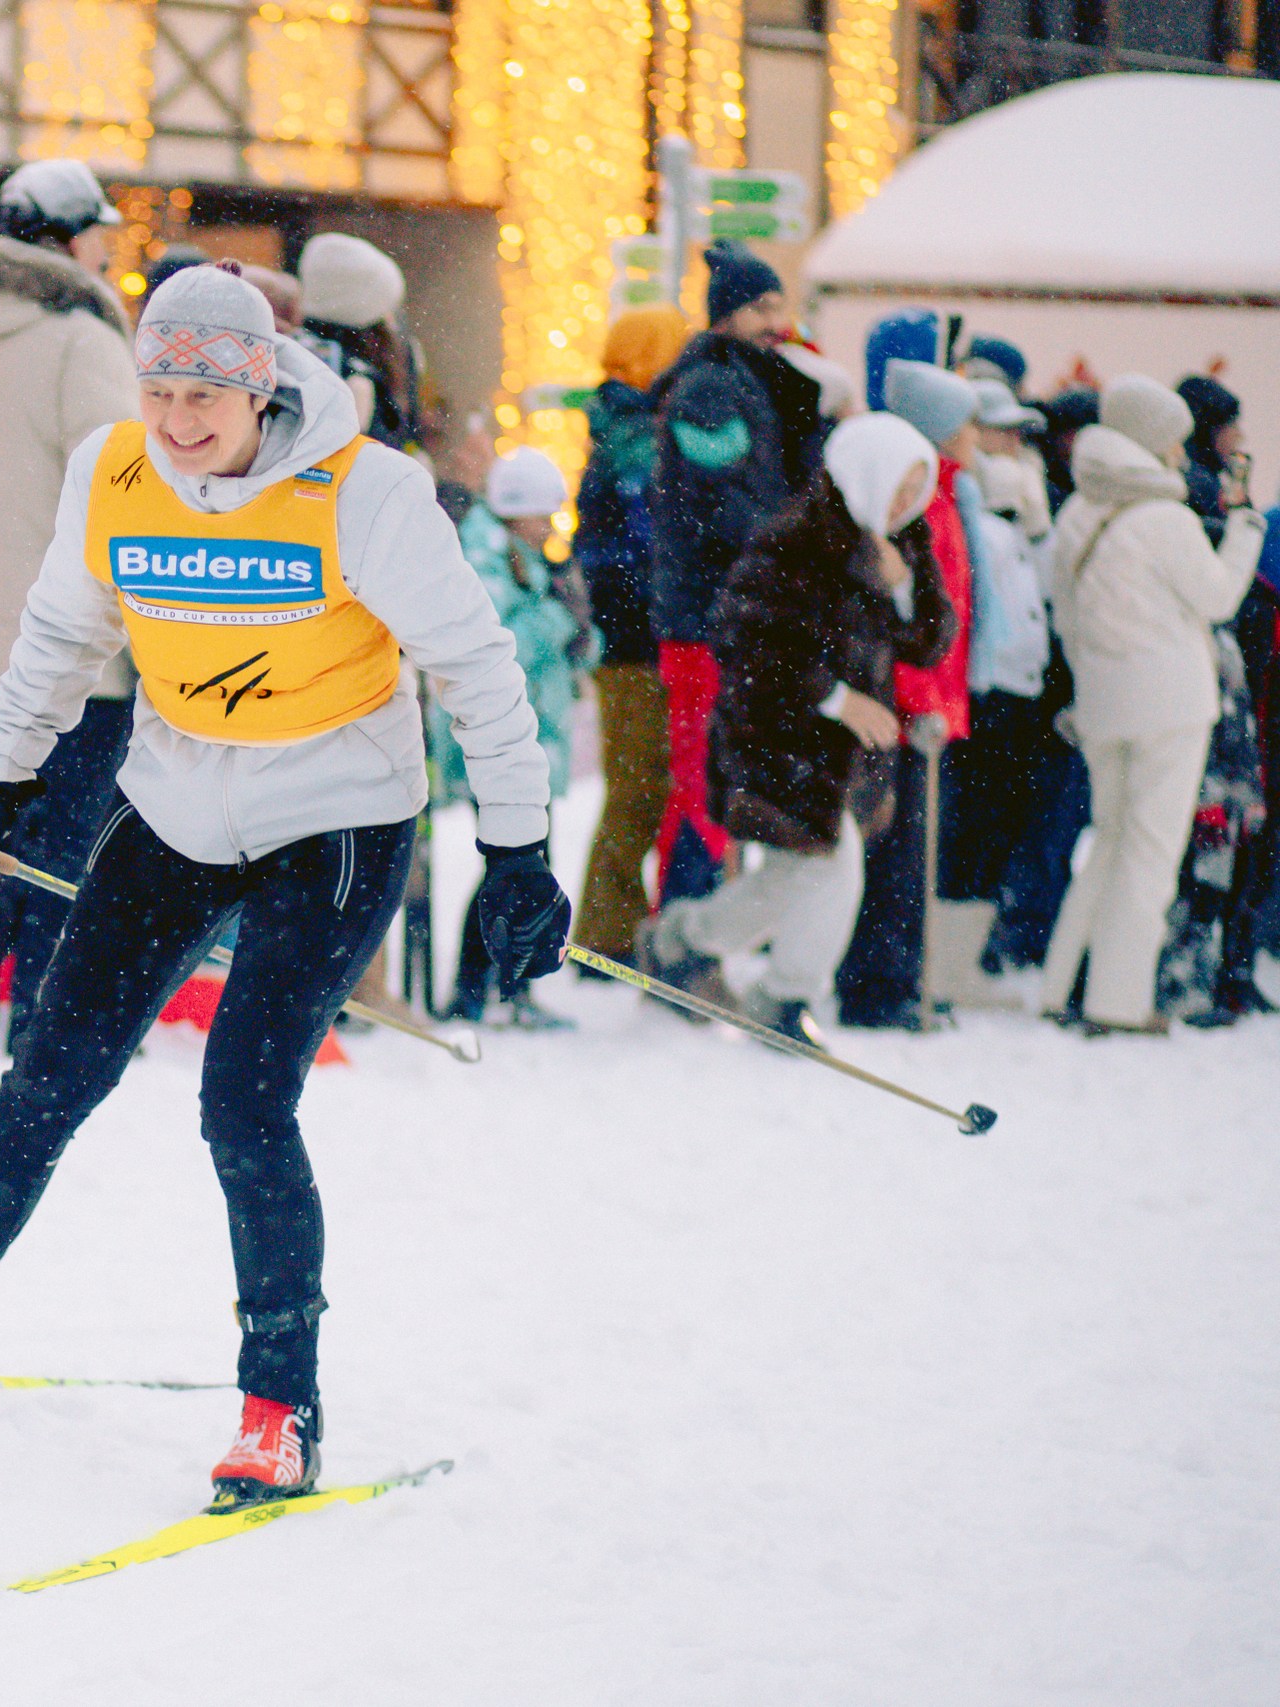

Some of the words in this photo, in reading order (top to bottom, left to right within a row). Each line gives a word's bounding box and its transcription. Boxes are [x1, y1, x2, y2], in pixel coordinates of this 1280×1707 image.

[118, 547, 312, 582] Buderus
[137, 605, 176, 619] WORLD
[184, 612, 205, 621] CUP
[213, 614, 255, 623] CROSS
[263, 606, 321, 623] COUNTRY
